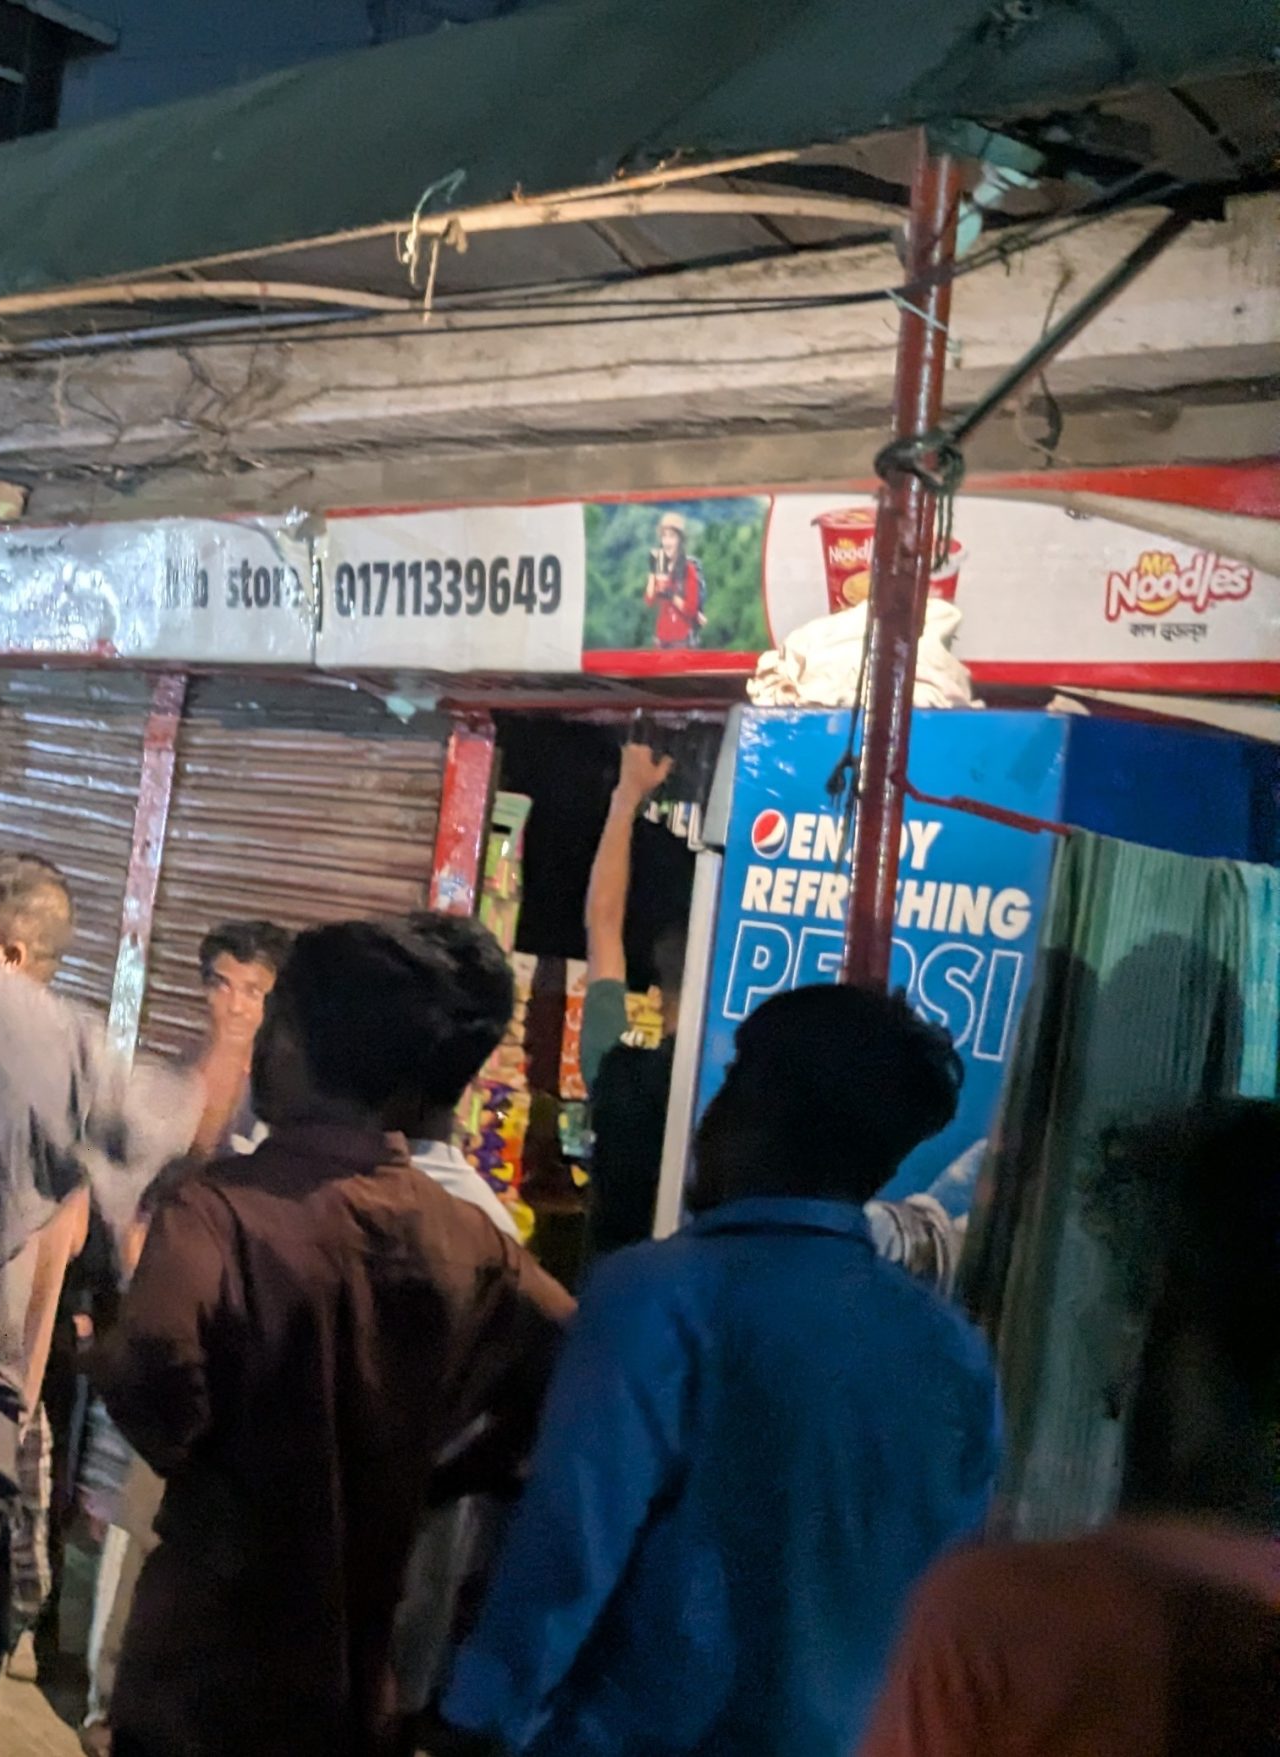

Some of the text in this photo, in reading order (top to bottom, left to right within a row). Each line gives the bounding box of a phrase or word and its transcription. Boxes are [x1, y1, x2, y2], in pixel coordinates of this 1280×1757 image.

[335, 554, 562, 618] 01711339649
[1105, 552, 1253, 621] Noodles
[788, 812, 943, 870] ENY
[741, 865, 1032, 941] REFRHING
[722, 920, 1024, 1061] PSI
